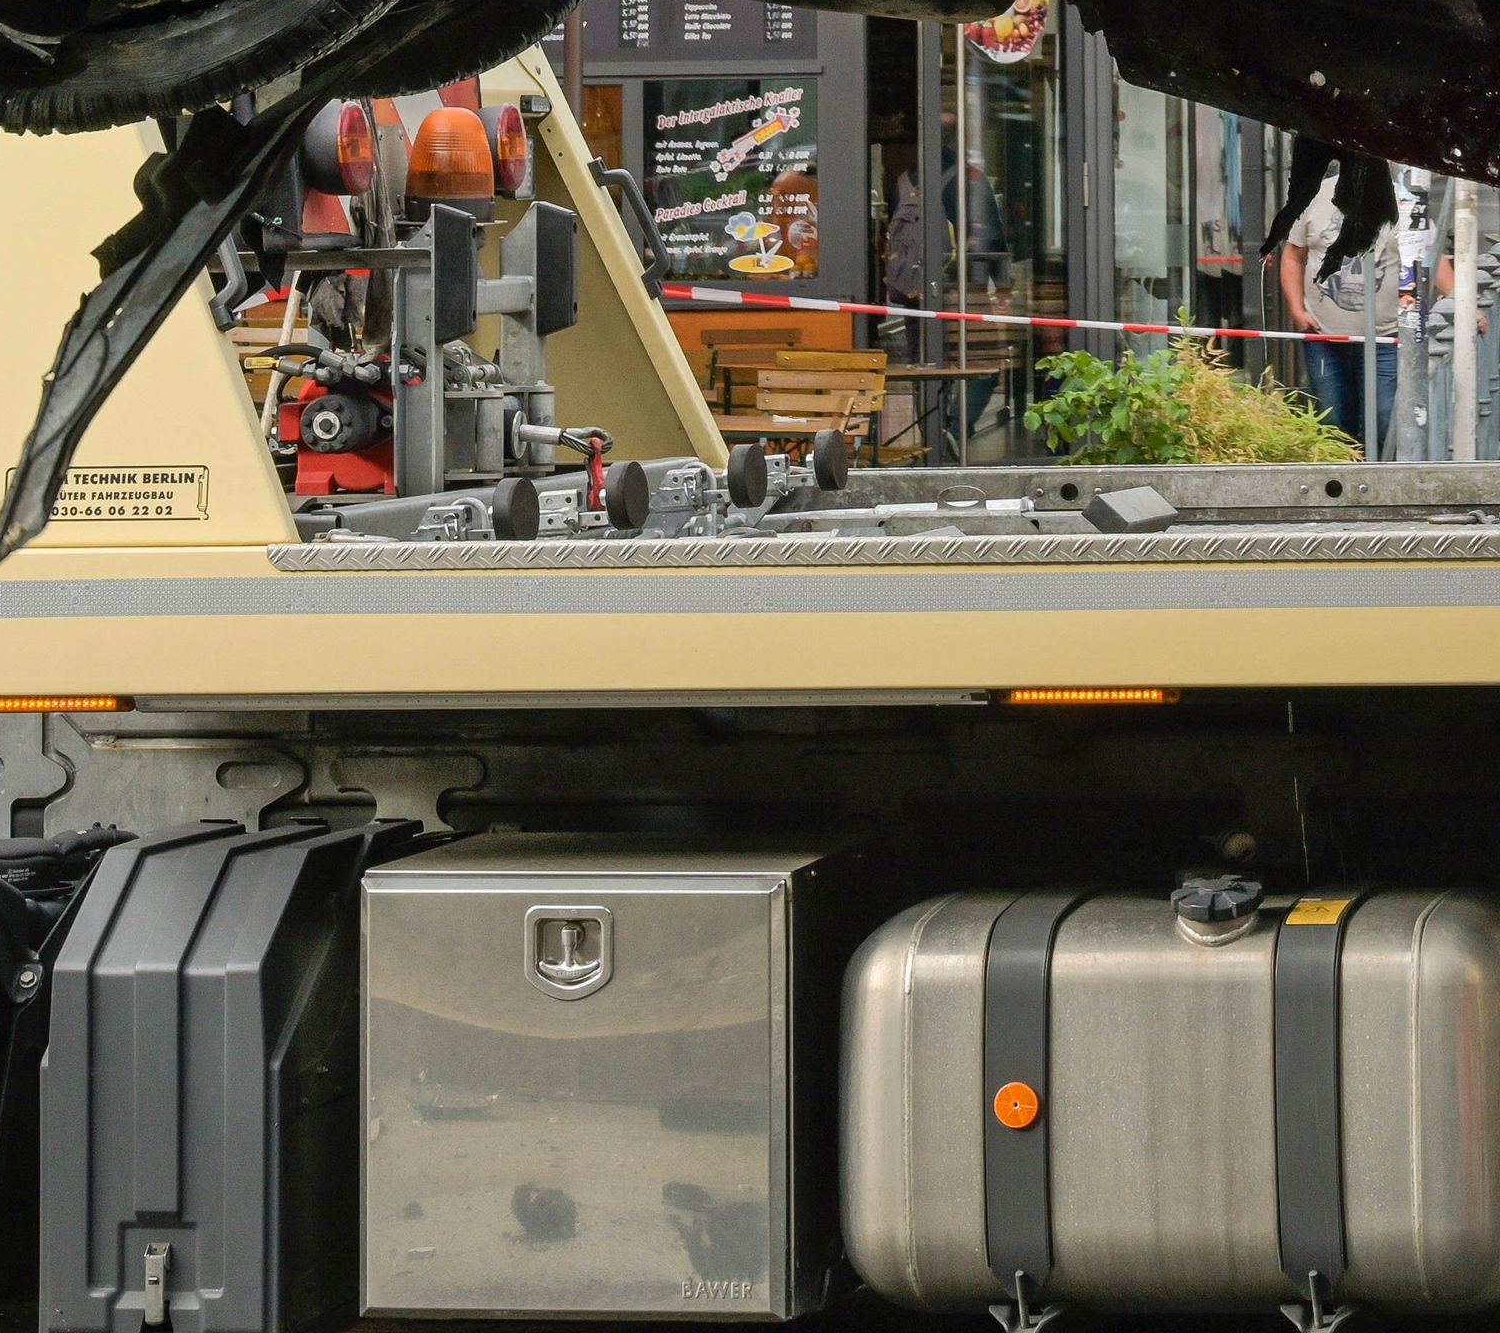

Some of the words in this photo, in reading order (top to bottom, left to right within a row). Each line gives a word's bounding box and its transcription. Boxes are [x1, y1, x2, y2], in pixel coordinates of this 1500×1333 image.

[657, 115, 677, 130] Der
[678, 95, 762, 124] Intergalaktische
[764, 87, 804, 107] Knaller
[655, 201, 701, 223] Paradies
[702, 190, 747, 213] Cocktail
[73, 474, 137, 484] TECHNIK
[143, 473, 195, 484] BERLIN
[91, 491, 174, 501] FAHRZEUGBAU
[108, 506, 125, 516] 06
[132, 506, 149, 516] 22
[155, 506, 173, 515] 02
[681, 1279, 754, 1300] BAWER
